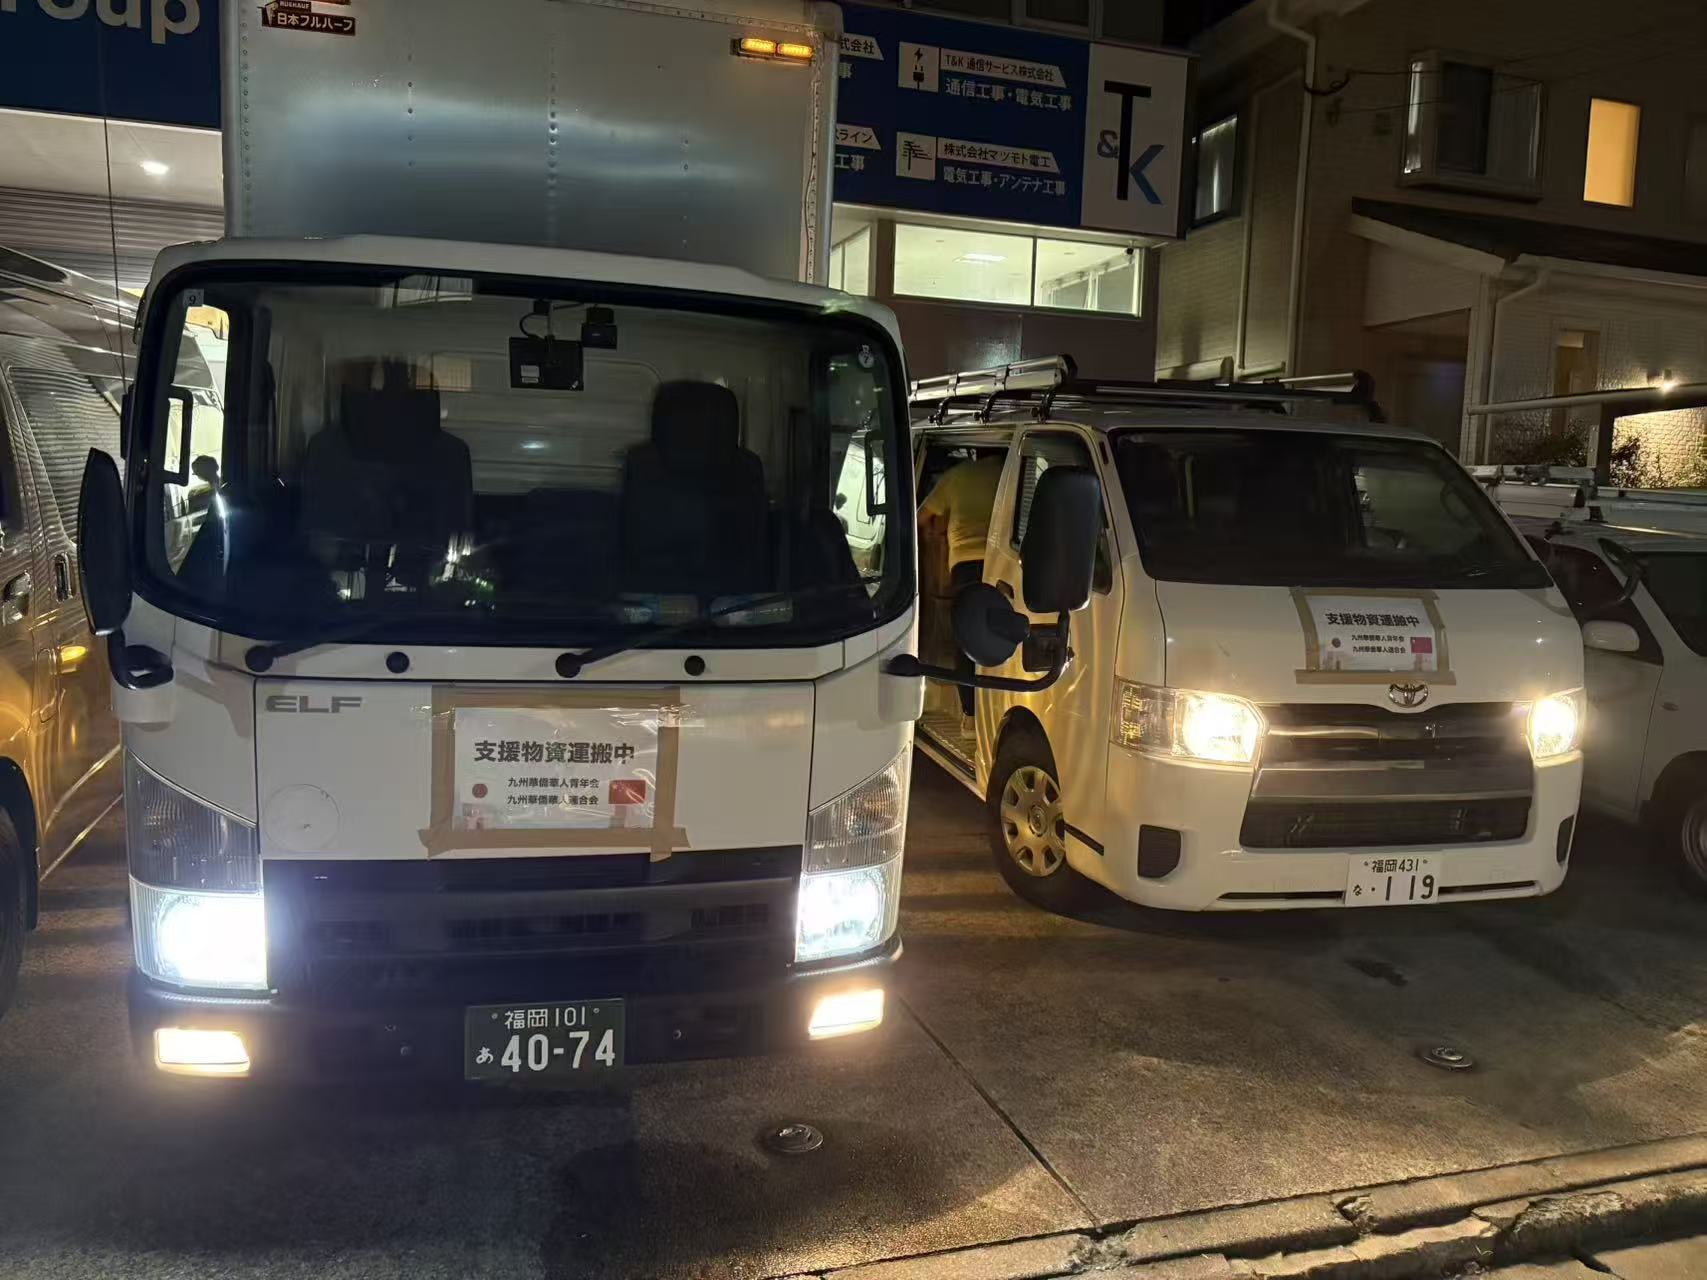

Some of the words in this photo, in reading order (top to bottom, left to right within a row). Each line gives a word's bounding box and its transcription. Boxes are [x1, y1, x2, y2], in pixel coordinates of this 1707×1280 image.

[277, 12, 353, 31] 日本フルハーフ
[945, 54, 964, 68] T&K
[967, 57, 1054, 82] 通信サービス株式会社
[944, 143, 1052, 168] 株式会社マツモト電工
[1325, 612, 1420, 628] 支援物資運搬中
[265, 695, 362, 713] ELF
[474, 740, 635, 765] 支援物資運搬中
[500, 1029, 616, 1073] 40-74
